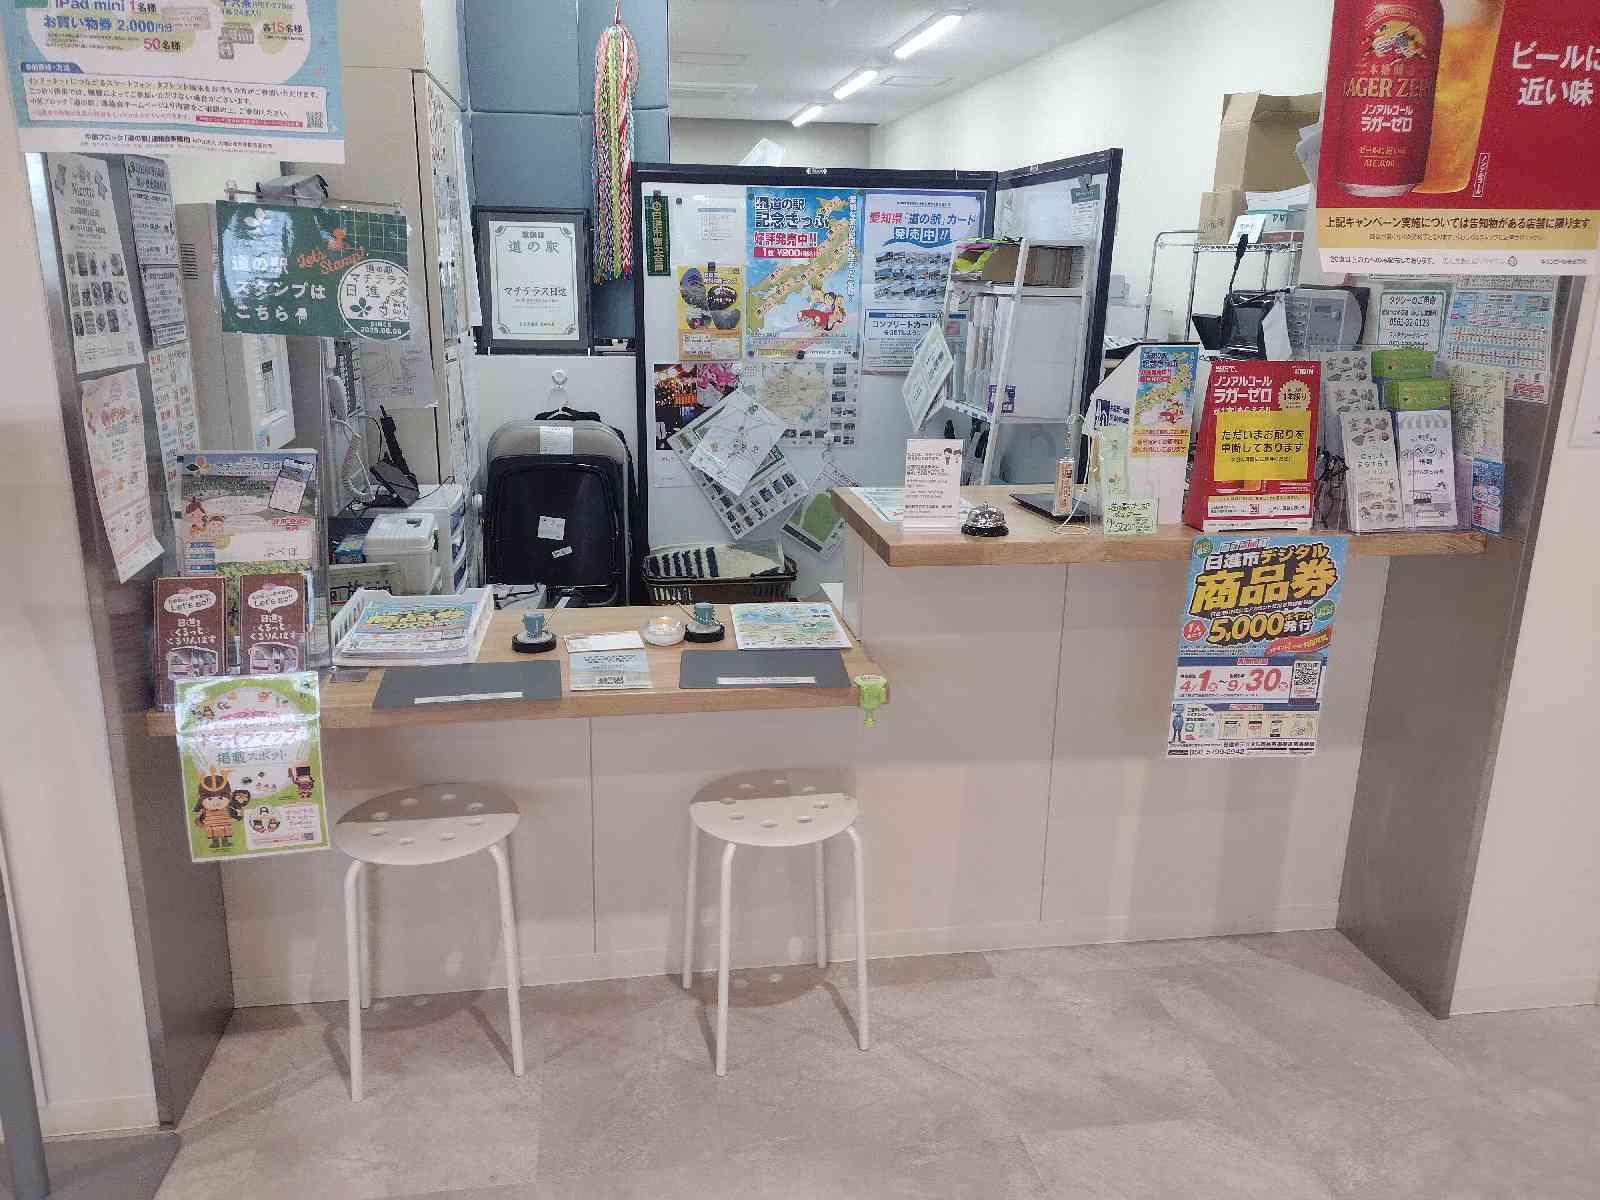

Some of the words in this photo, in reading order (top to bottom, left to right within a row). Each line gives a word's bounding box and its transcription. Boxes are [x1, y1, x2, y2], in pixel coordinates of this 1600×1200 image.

[44, 15, 113, 31] お買い物券
[144, 37, 182, 51] 50名様
[1512, 41, 1600, 71] ビールに
[1517, 76, 1593, 107] 近い味
[1361, 105, 1414, 116] ノンアルコール
[1360, 116, 1413, 133] ラガーゼロ
[770, 197, 806, 211] 道の駅
[755, 212, 830, 229] 記念きっぷ
[1326, 215, 1591, 230] 上記キャンペーン実施については告知物がある店舗に限ります
[894, 227, 951, 241] 発売中!!
[507, 239, 561, 254] 道の駅
[231, 254, 288, 275] 道の駅
[237, 280, 326, 301] スタンプは
[346, 283, 381, 298] 日進
[503, 286, 569, 297] マチテラス日進
[235, 305, 289, 322] こちら
[1213, 376, 1273, 387] ノンアルコール
[1213, 387, 1272, 404] ラガーゼロ
[1221, 429, 1305, 441] ただいまお配りを
[1221, 443, 1304, 454] 中断しております
[1204, 542, 1330, 571] 日進市デジタル
[1189, 558, 1338, 615] 商品券
[1207, 612, 1286, 644] 5,000
[1283, 620, 1313, 633] 発行
